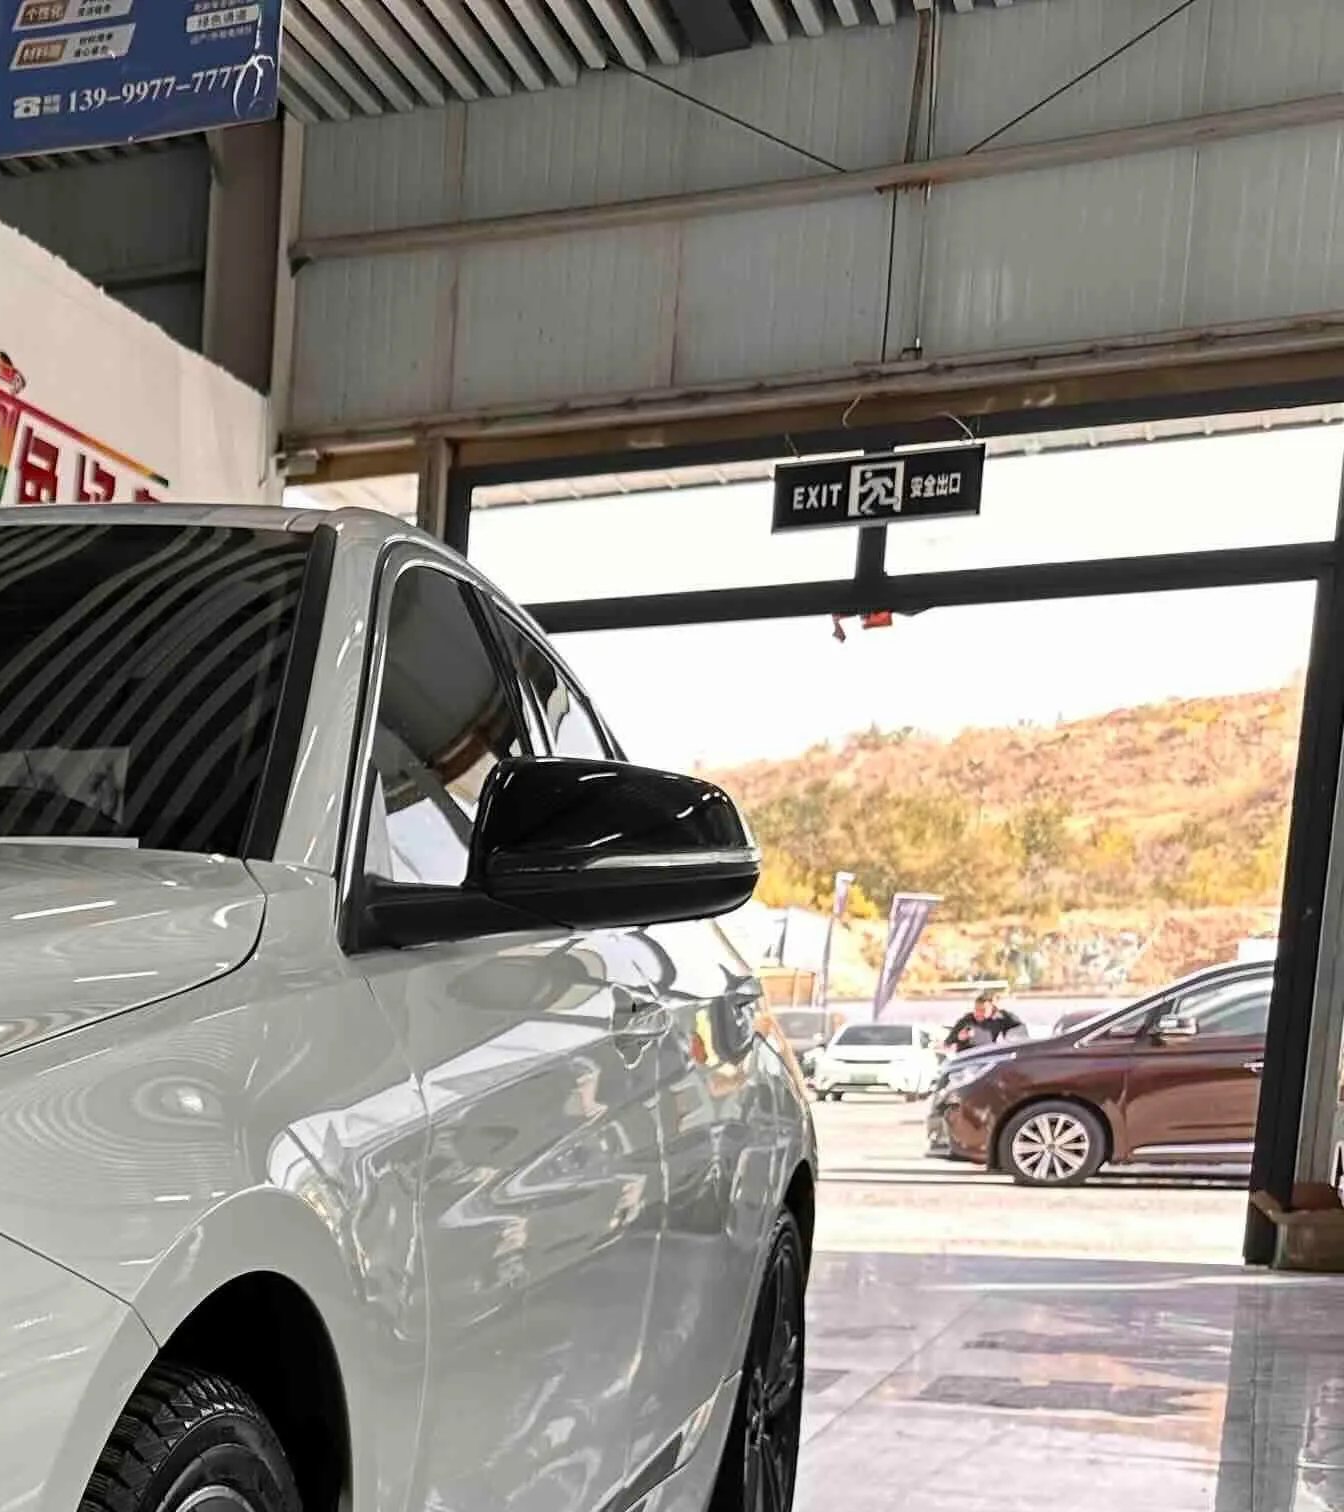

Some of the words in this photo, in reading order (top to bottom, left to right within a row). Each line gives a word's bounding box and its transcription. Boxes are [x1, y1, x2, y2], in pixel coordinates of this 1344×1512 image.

[792, 482, 843, 511] EXIT
[910, 472, 961, 498] 安全出口
